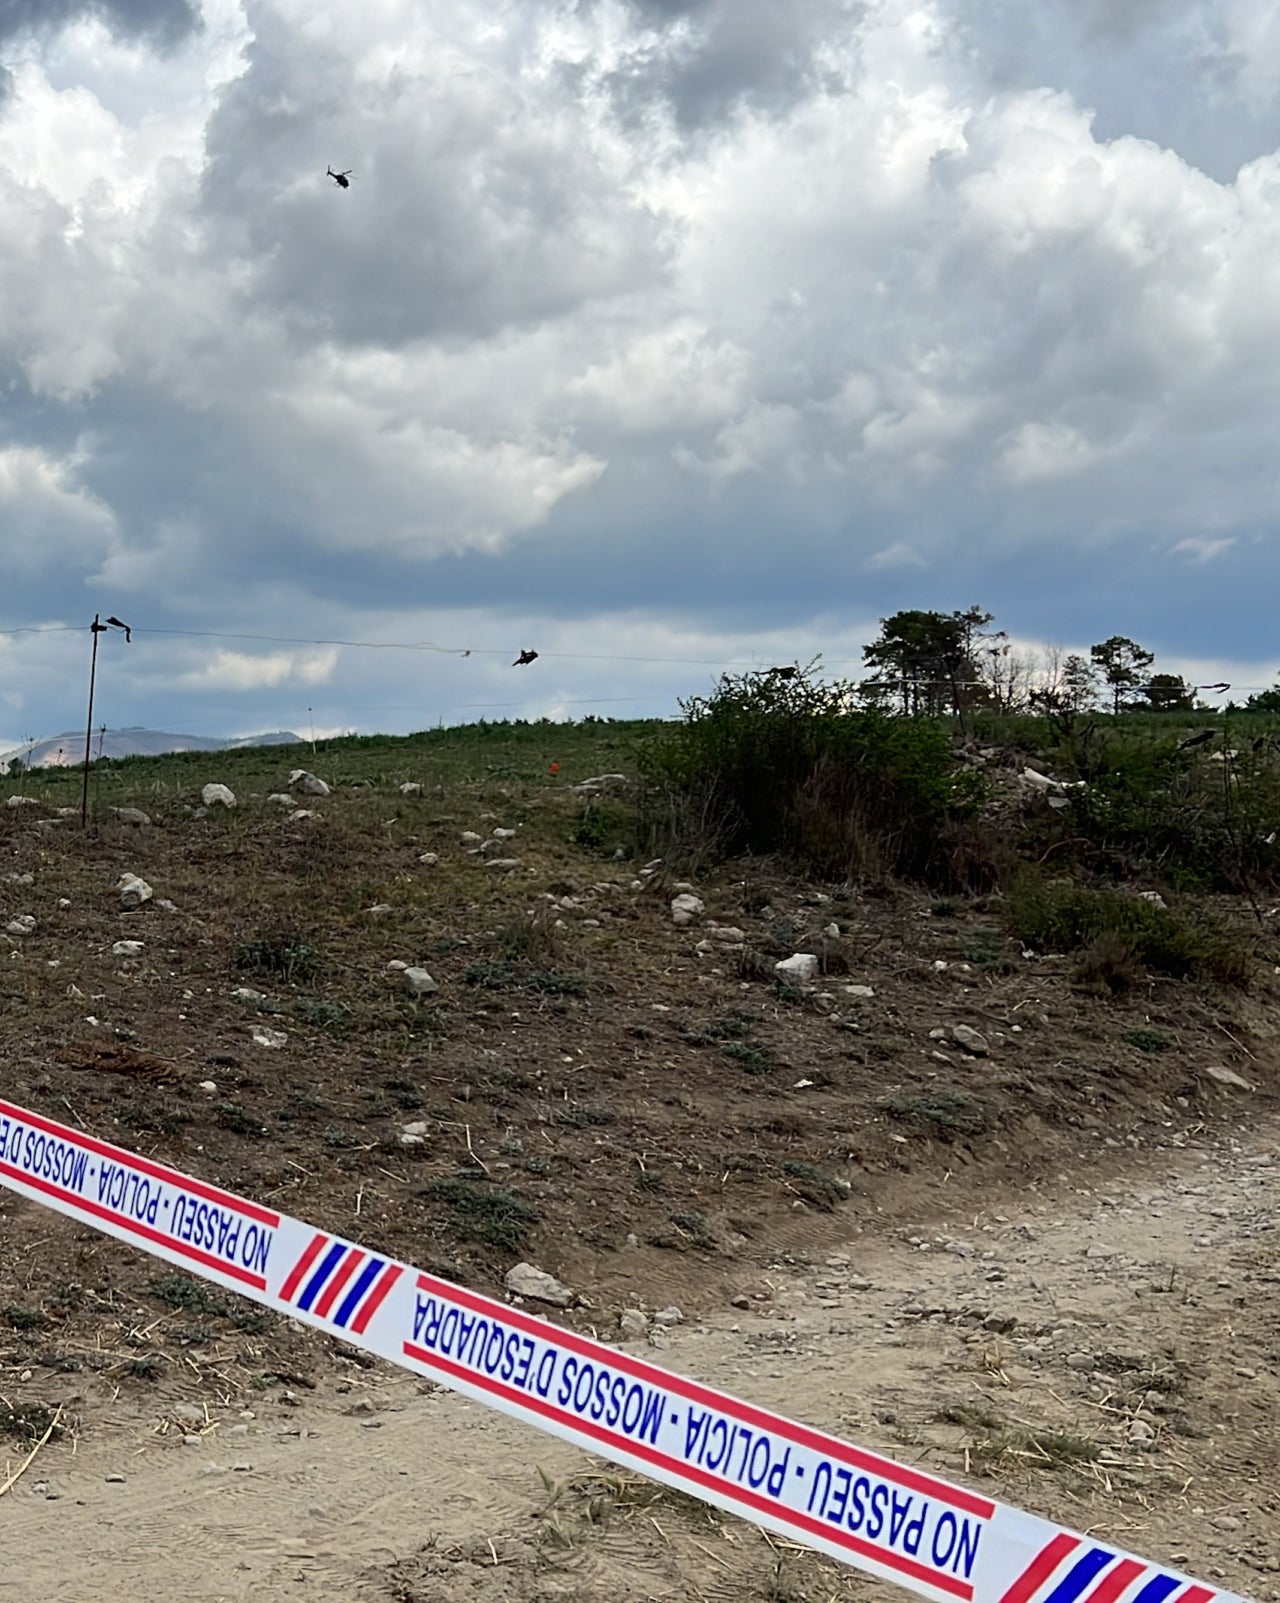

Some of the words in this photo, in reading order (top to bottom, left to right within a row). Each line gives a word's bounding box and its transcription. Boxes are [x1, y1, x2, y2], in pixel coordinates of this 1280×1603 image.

[24, 1132, 88, 1192] MOSSOS
[98, 1162, 161, 1224] POLICIA
[171, 1195, 241, 1260] PASSEU
[243, 1226, 272, 1273] NO
[413, 1294, 556, 1397] D'ESQUADRA
[558, 1357, 665, 1445] MOSSOS
[685, 1407, 790, 1497] POLICIA
[807, 1462, 926, 1553] PASSEU
[933, 1513, 981, 1577] NO
